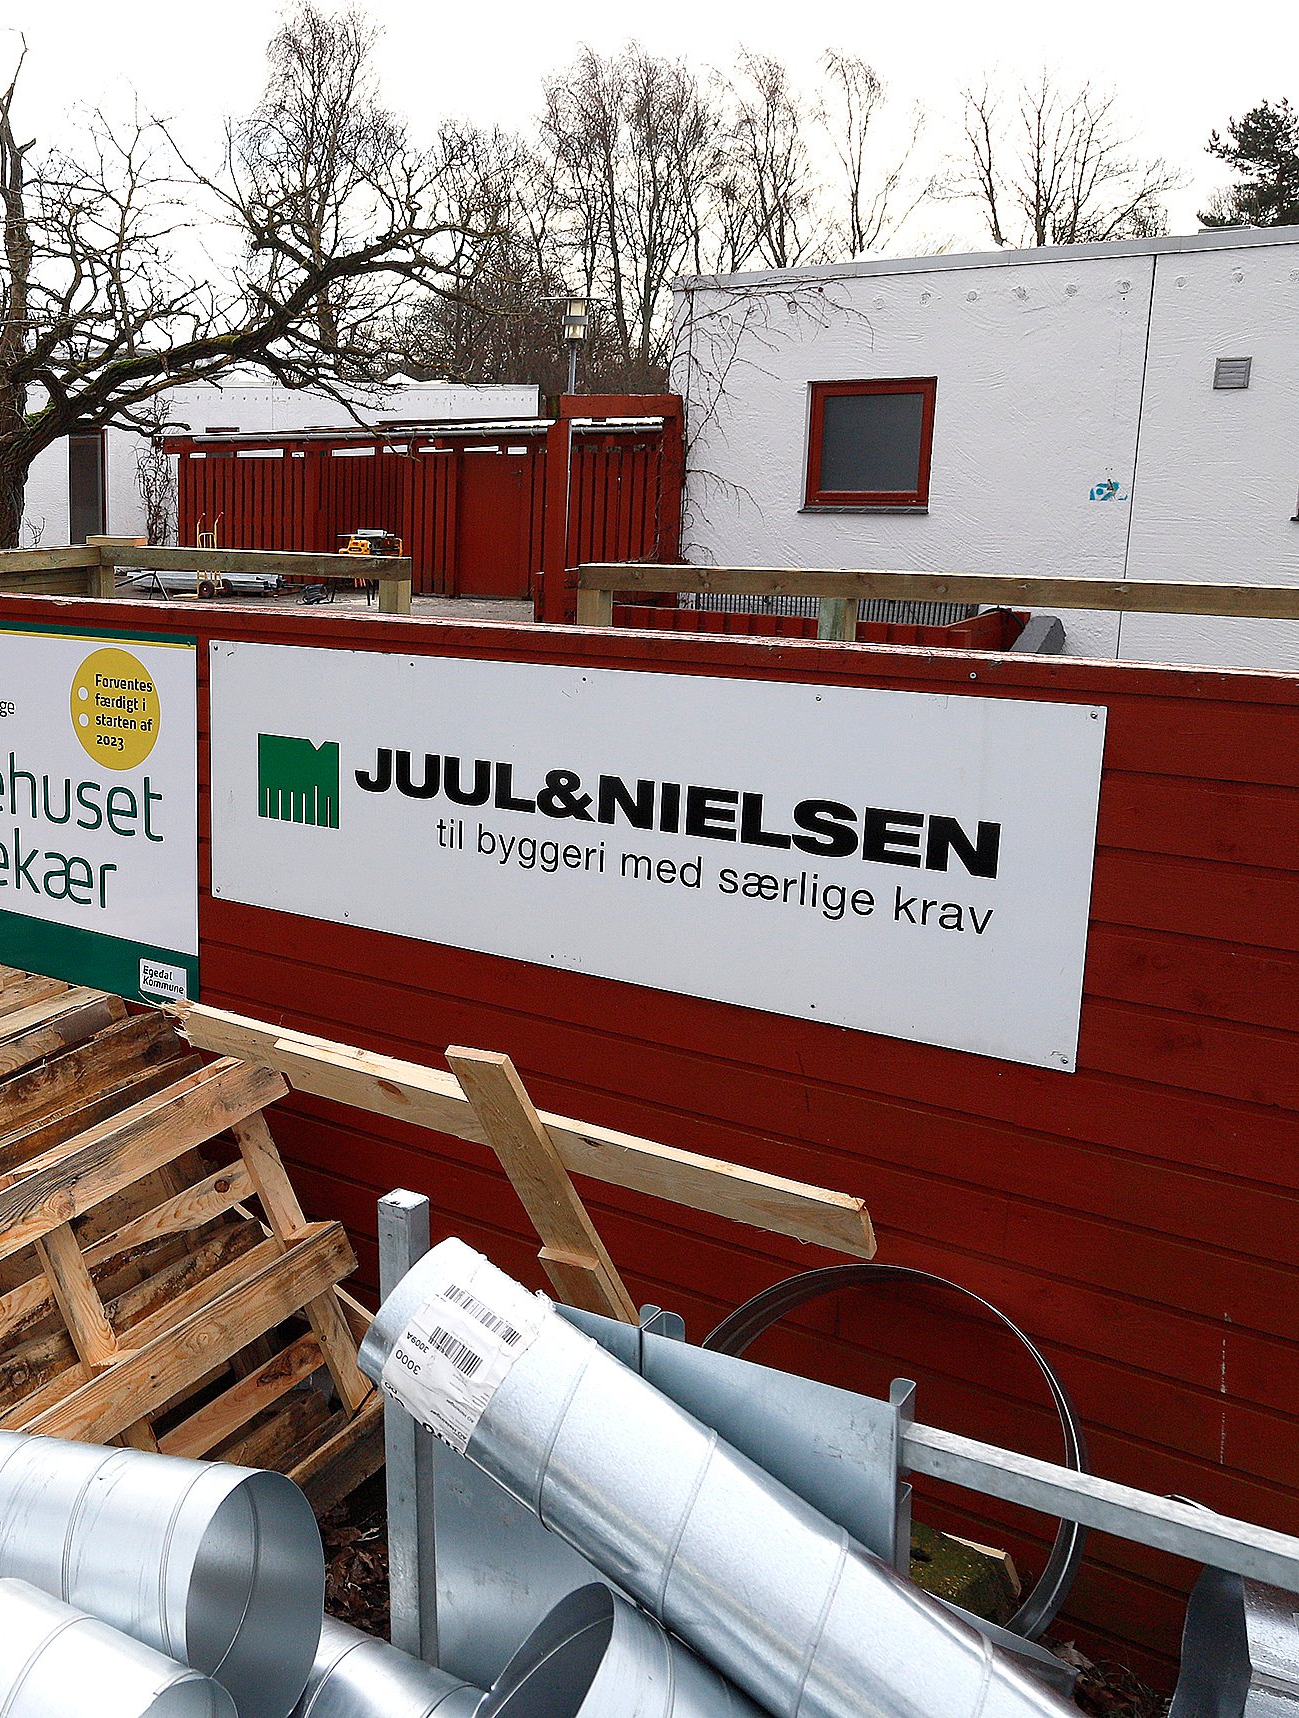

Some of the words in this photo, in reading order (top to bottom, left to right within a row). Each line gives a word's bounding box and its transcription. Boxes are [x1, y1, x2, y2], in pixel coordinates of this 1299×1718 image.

[95, 674, 153, 693] Forventes
[95, 693, 139, 713] færdigt
[142, 698, 147, 712] i
[95, 713, 136, 730] starten
[139, 718, 153, 732] af
[96, 734, 124, 751] 2023
[355, 746, 1002, 880] JUUL&NIELSEN
[436, 818, 465, 851] til
[477, 821, 607, 876] byggeri
[620, 851, 703, 890] med
[719, 866, 875, 922] særlige
[893, 885, 995, 936] krav
[143, 965, 172, 981] Egedal
[143, 975, 184, 995] Kommune
[407, 1331, 430, 1354] 3009A
[395, 1349, 421, 1376] 3000
